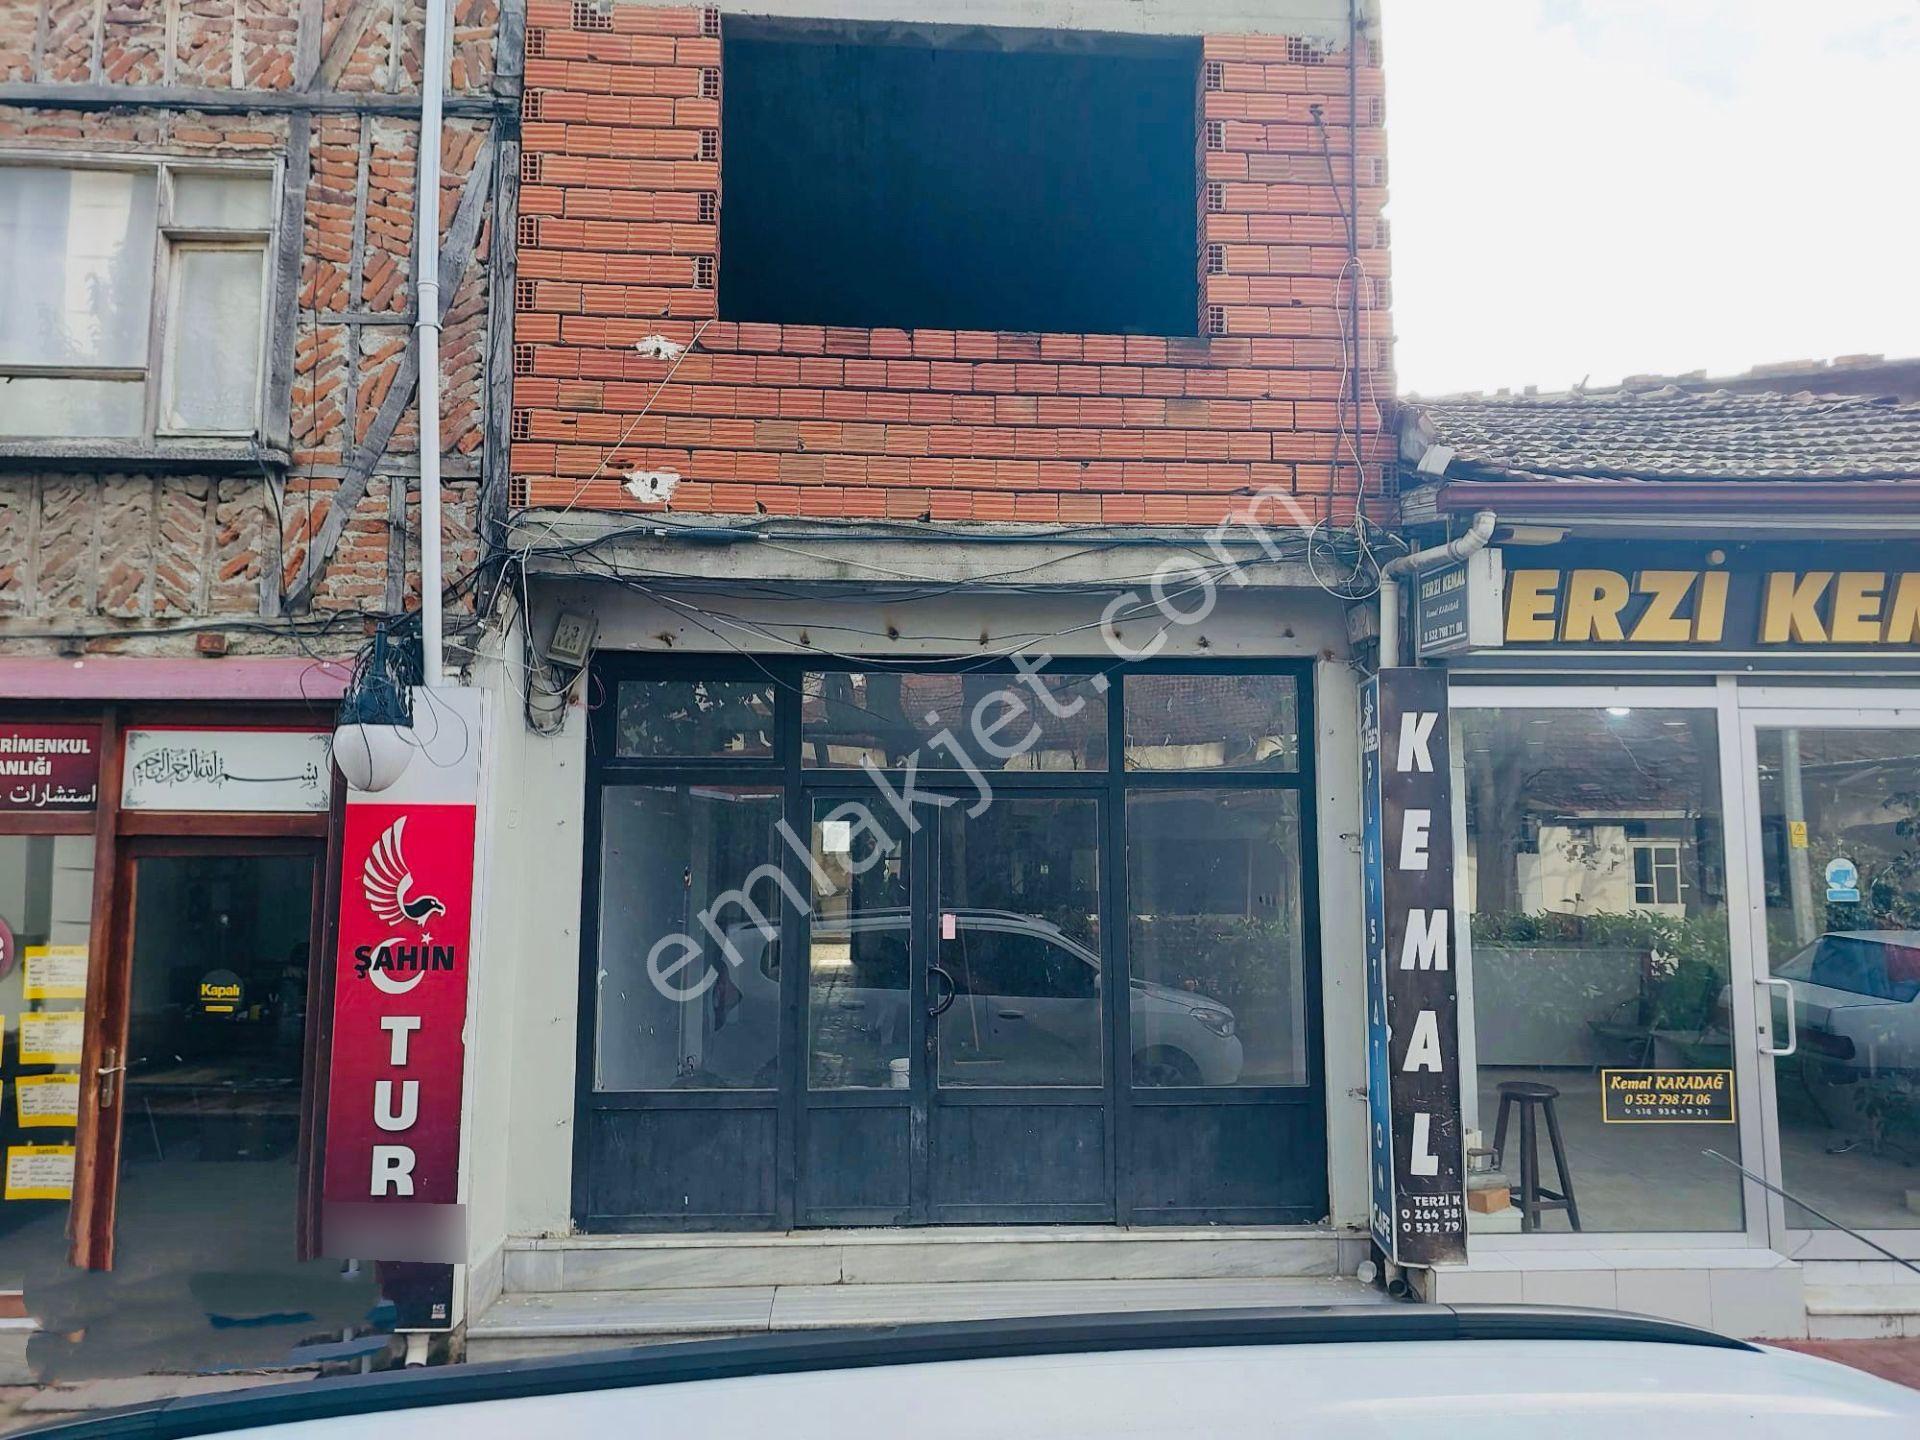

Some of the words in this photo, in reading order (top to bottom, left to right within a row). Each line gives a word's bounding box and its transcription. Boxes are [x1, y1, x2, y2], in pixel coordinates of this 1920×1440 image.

[1442, 568, 1466, 592] KEMAL
[1503, 550, 1729, 642] ERZİ
[0, 734, 91, 753] RİMENKUL
[9, 783, 96, 807] استشارات
[1397, 712, 1449, 1176] KEMAL
[201, 983, 240, 998] Kapalı
[1611, 1076, 1652, 1090] Kemal
[1655, 1074, 1724, 1090] KARADAĞ
[370, 1016, 421, 1196] TUR
[1624, 1094, 1633, 1105] 0
[1635, 1094, 1656, 1105] 532
[1659, 1094, 1680, 1105] 798
[1681, 1094, 1694, 1105] 71
[1696, 1094, 1711, 1105] 06
[1413, 1194, 1449, 1207] TERZİ
[1402, 1209, 1410, 1219] 0
[1415, 1209, 1439, 1220] 264
[1444, 1208, 1461, 1219] 58
[1402, 1222, 1411, 1233] 0
[1416, 1222, 1440, 1233] 532
[1444, 1221, 1462, 1232] 79
